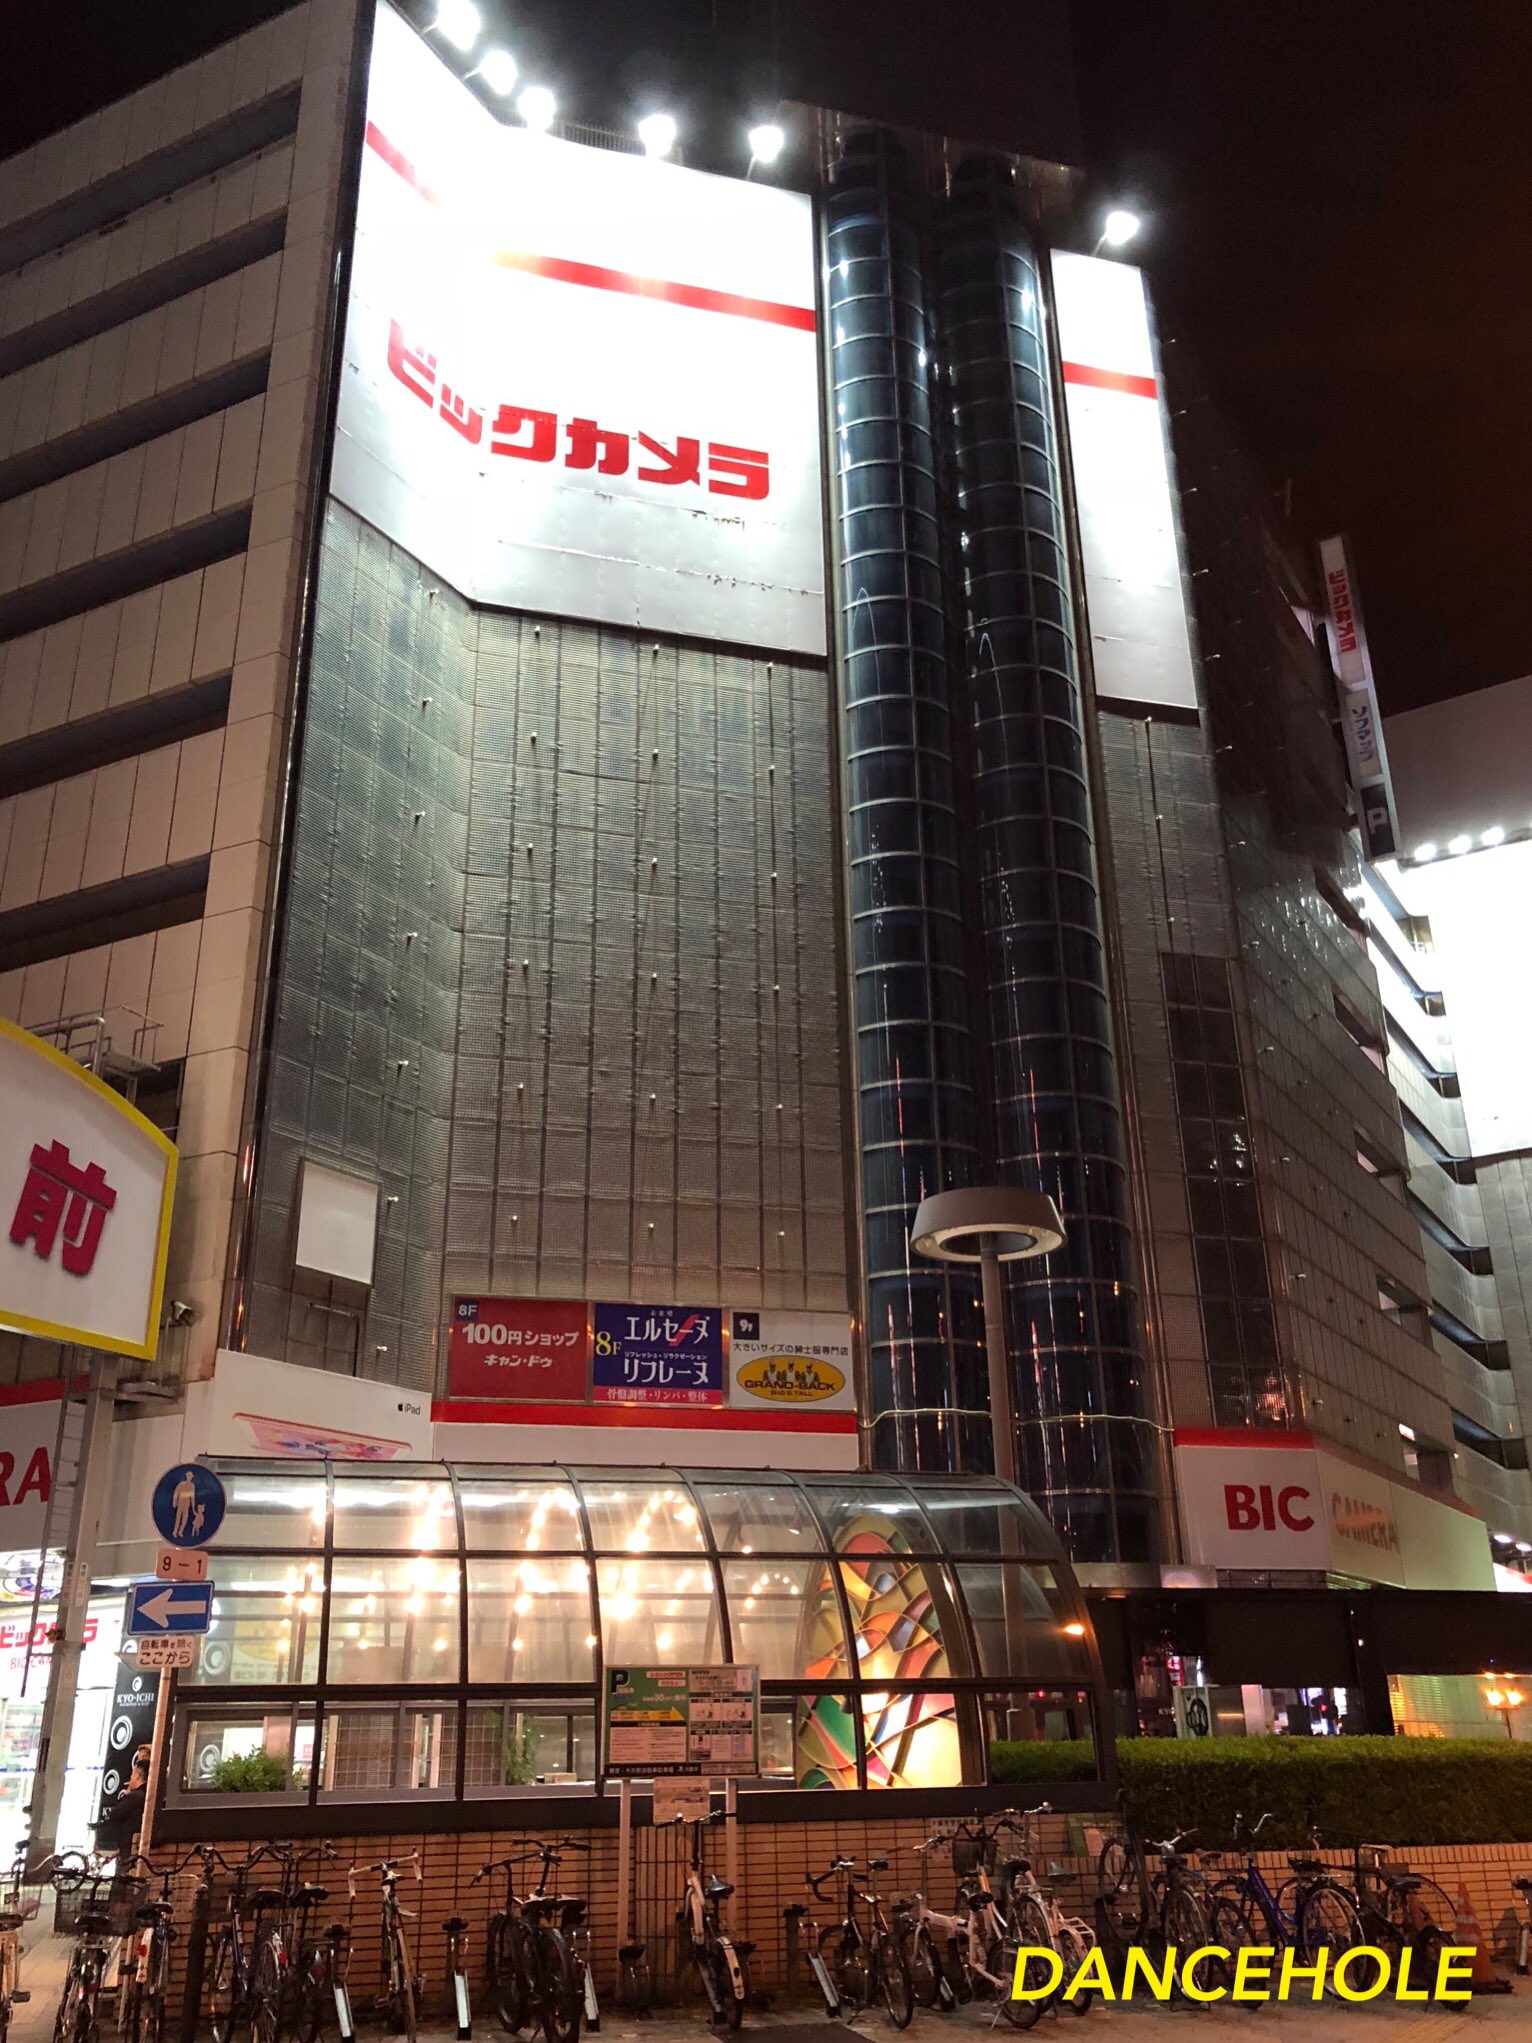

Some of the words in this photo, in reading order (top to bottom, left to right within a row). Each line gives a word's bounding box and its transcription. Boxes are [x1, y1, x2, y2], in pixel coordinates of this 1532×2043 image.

[388, 318, 770, 500] ビックカメラ
[1367, 807, 1387, 834] P
[10, 1138, 117, 1274] 前
[458, 1304, 477, 1317] 8F
[462, 1323, 580, 1346] 100円ショップ
[595, 1331, 622, 1356] 8F
[732, 1343, 849, 1356] 大きいサイズの紳士服専門店
[624, 1358, 709, 1385] リフレーヌ
[404, 1402, 421, 1415] iPad
[1224, 1484, 1315, 1532] BIC
[140, 1652, 191, 1665] ここから
[610, 1670, 631, 1695] P
[117, 1692, 154, 1703] KYO-ICHI
